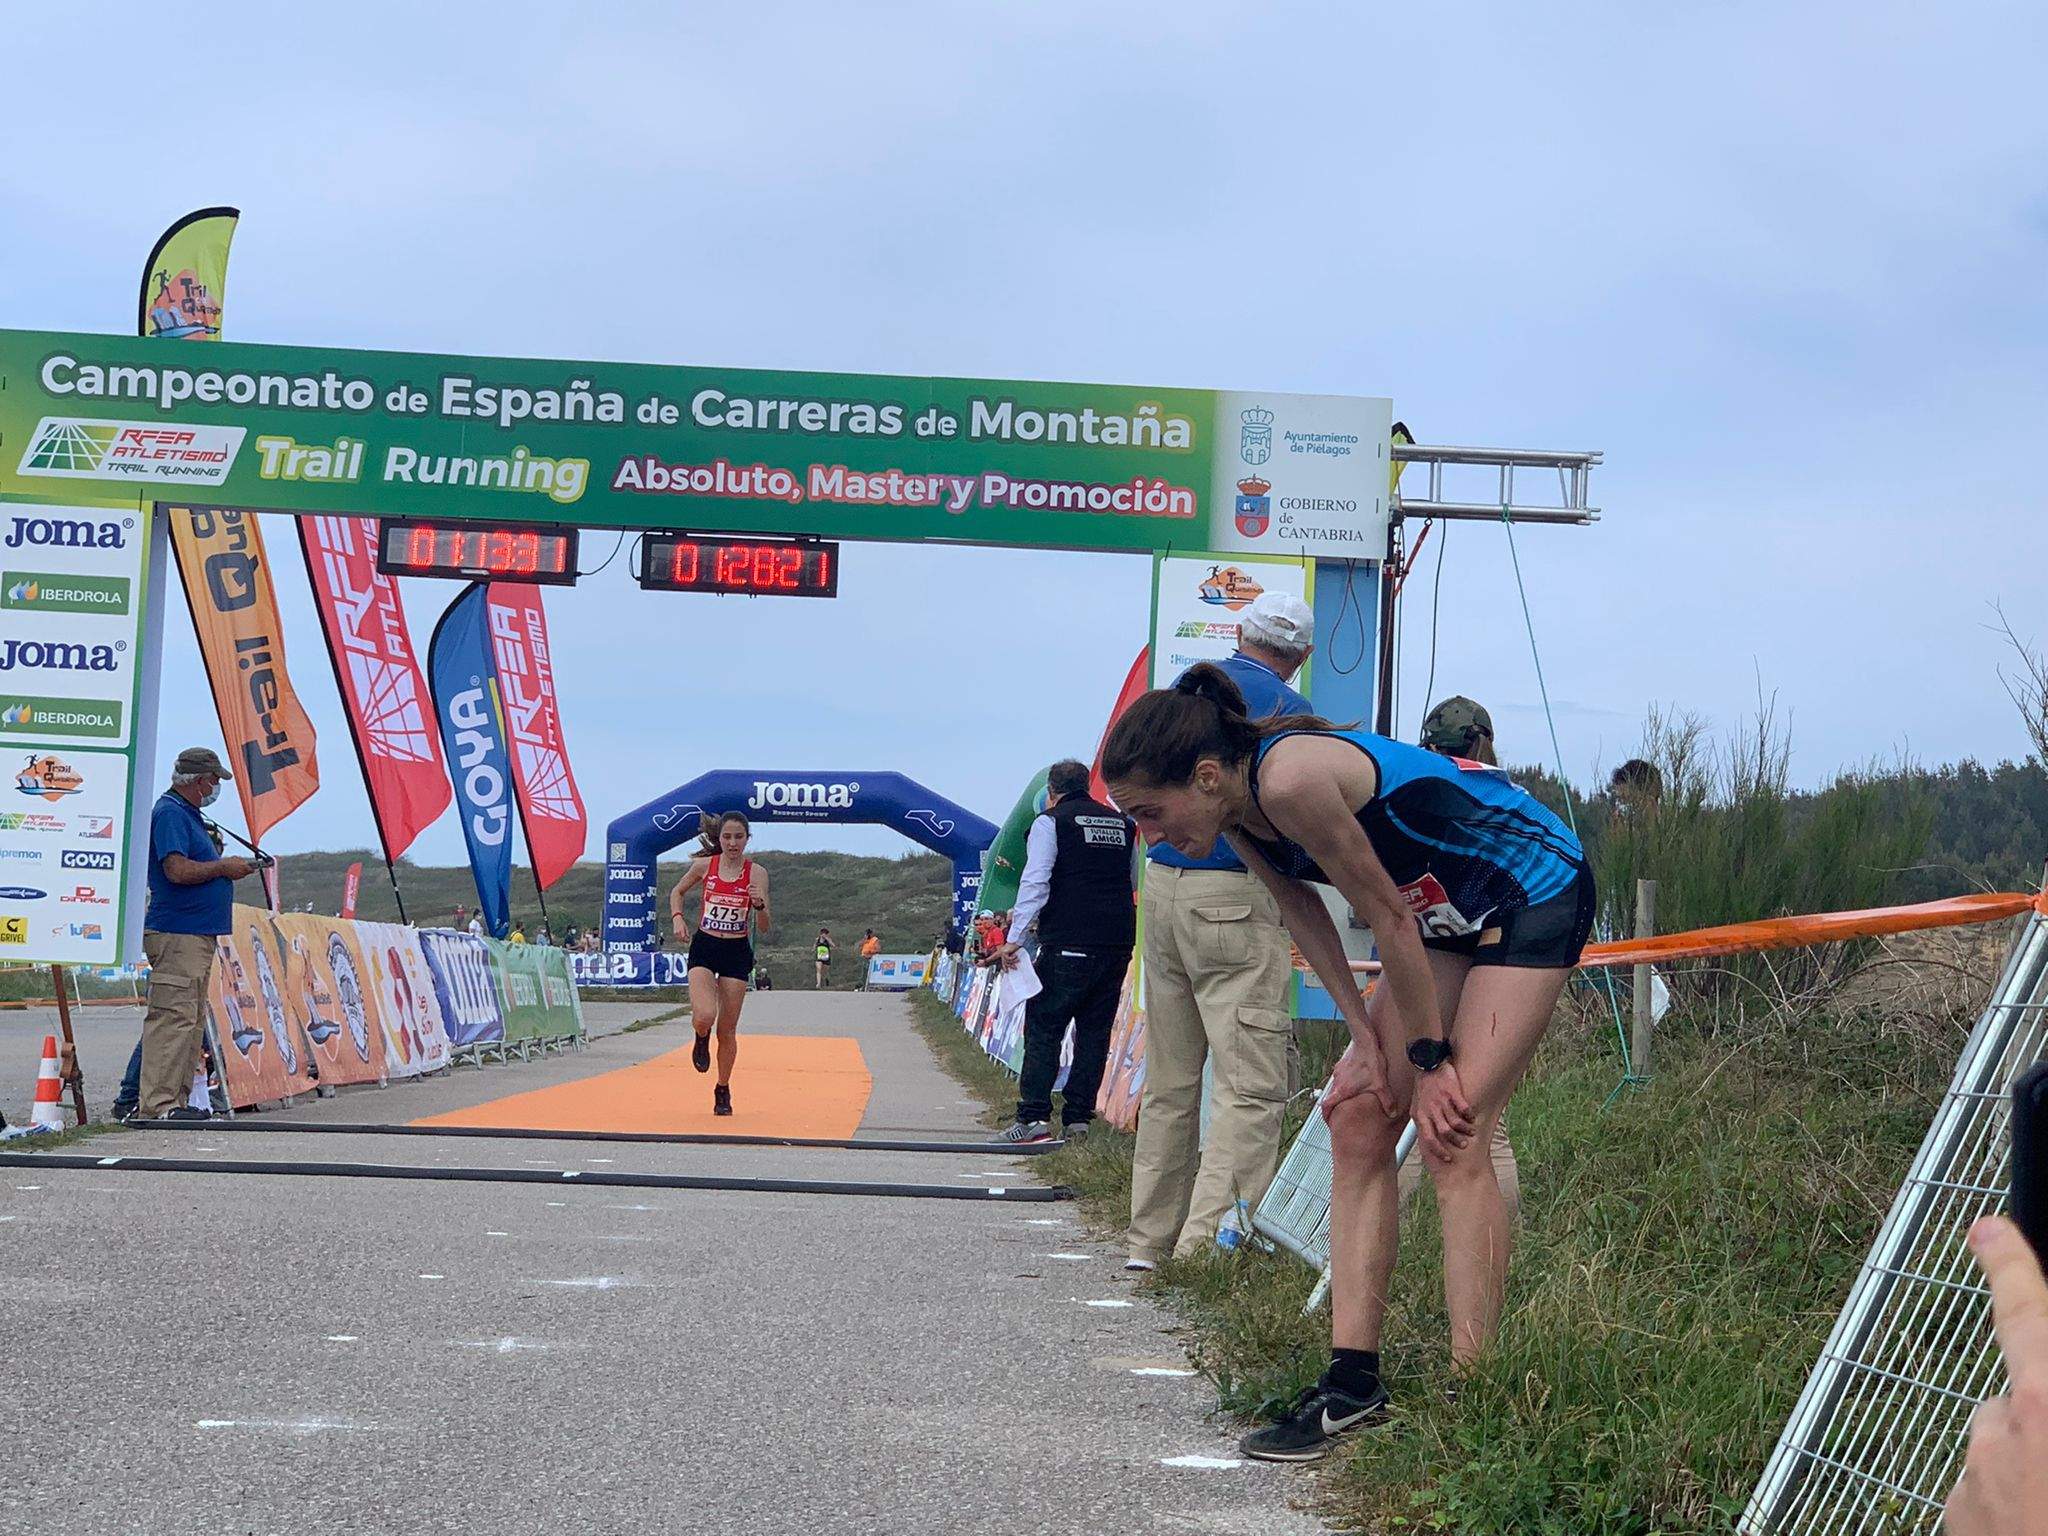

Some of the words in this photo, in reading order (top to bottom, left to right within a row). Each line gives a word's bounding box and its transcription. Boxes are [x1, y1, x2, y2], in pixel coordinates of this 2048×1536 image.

[41, 355, 375, 411] Campeonato
[385, 385, 429, 413] de
[441, 377, 625, 427] España
[636, 397, 680, 425] de
[691, 389, 904, 435] Carreras
[915, 408, 958, 437] de
[970, 400, 1191, 449] Montaña
[119, 428, 197, 447] RFEA
[1283, 430, 1359, 444] Ayuntamiento
[112, 446, 226, 463] ATLETISMO
[1290, 442, 1304, 453] de
[1306, 443, 1351, 457] Piélagos
[107, 462, 149, 474] TRAIL
[155, 464, 222, 477] RUNNING
[260, 439, 364, 480] Trail
[383, 446, 587, 499] Running
[613, 459, 801, 499] Absoluto,
[811, 467, 944, 501] Master
[949, 479, 975, 510] y
[982, 475, 1193, 514] Promoción
[1279, 497, 1358, 512] GOBIERNO
[1279, 512, 1294, 524] de
[1278, 526, 1364, 541] CANTABRIA
[312, 515, 377, 654] RFE
[40, 588, 122, 604] IBERDROLA
[490, 603, 543, 742] RFEA
[524, 607, 559, 747] ATLETISMO
[34, 711, 114, 727] IBERDROLA
[234, 635, 301, 798] Trail
[448, 684, 508, 846] GOYA
[1092, 834, 1122, 844] AMIGO
[64, 852, 113, 867] GOYA
[710, 906, 739, 922] 475
[0, 933, 26, 943] GRIVEL
[571, 953, 638, 979] ma
